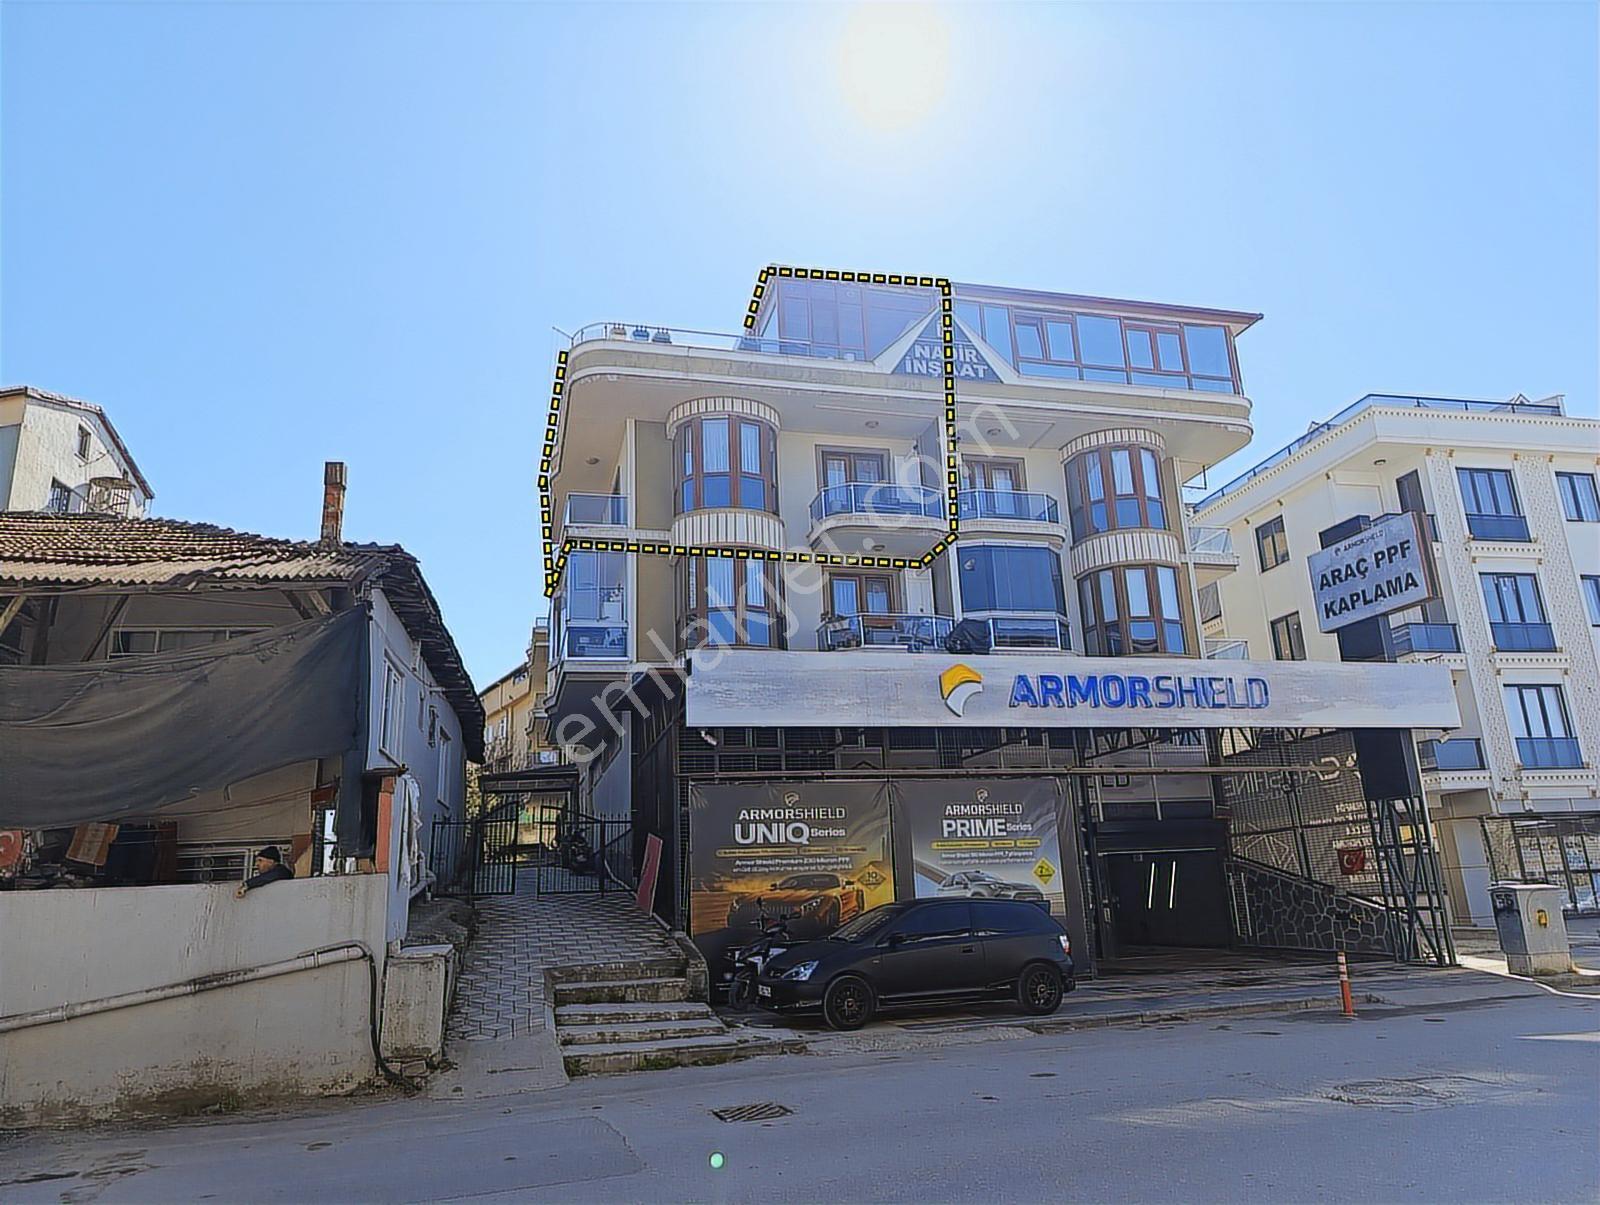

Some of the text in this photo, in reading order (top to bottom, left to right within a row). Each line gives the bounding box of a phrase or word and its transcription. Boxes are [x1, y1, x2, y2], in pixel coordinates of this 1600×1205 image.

[1319, 539, 1411, 591] ARAÇ PPF
[1323, 571, 1420, 619] KAPLAMA
[1008, 674, 1270, 709] ARMORSHIELD
[738, 807, 846, 821] ARMORSHIELD
[945, 803, 1023, 816] ARMORSHIELD
[734, 822, 846, 845] UNIQ Series
[942, 818, 1007, 838] PRIME
